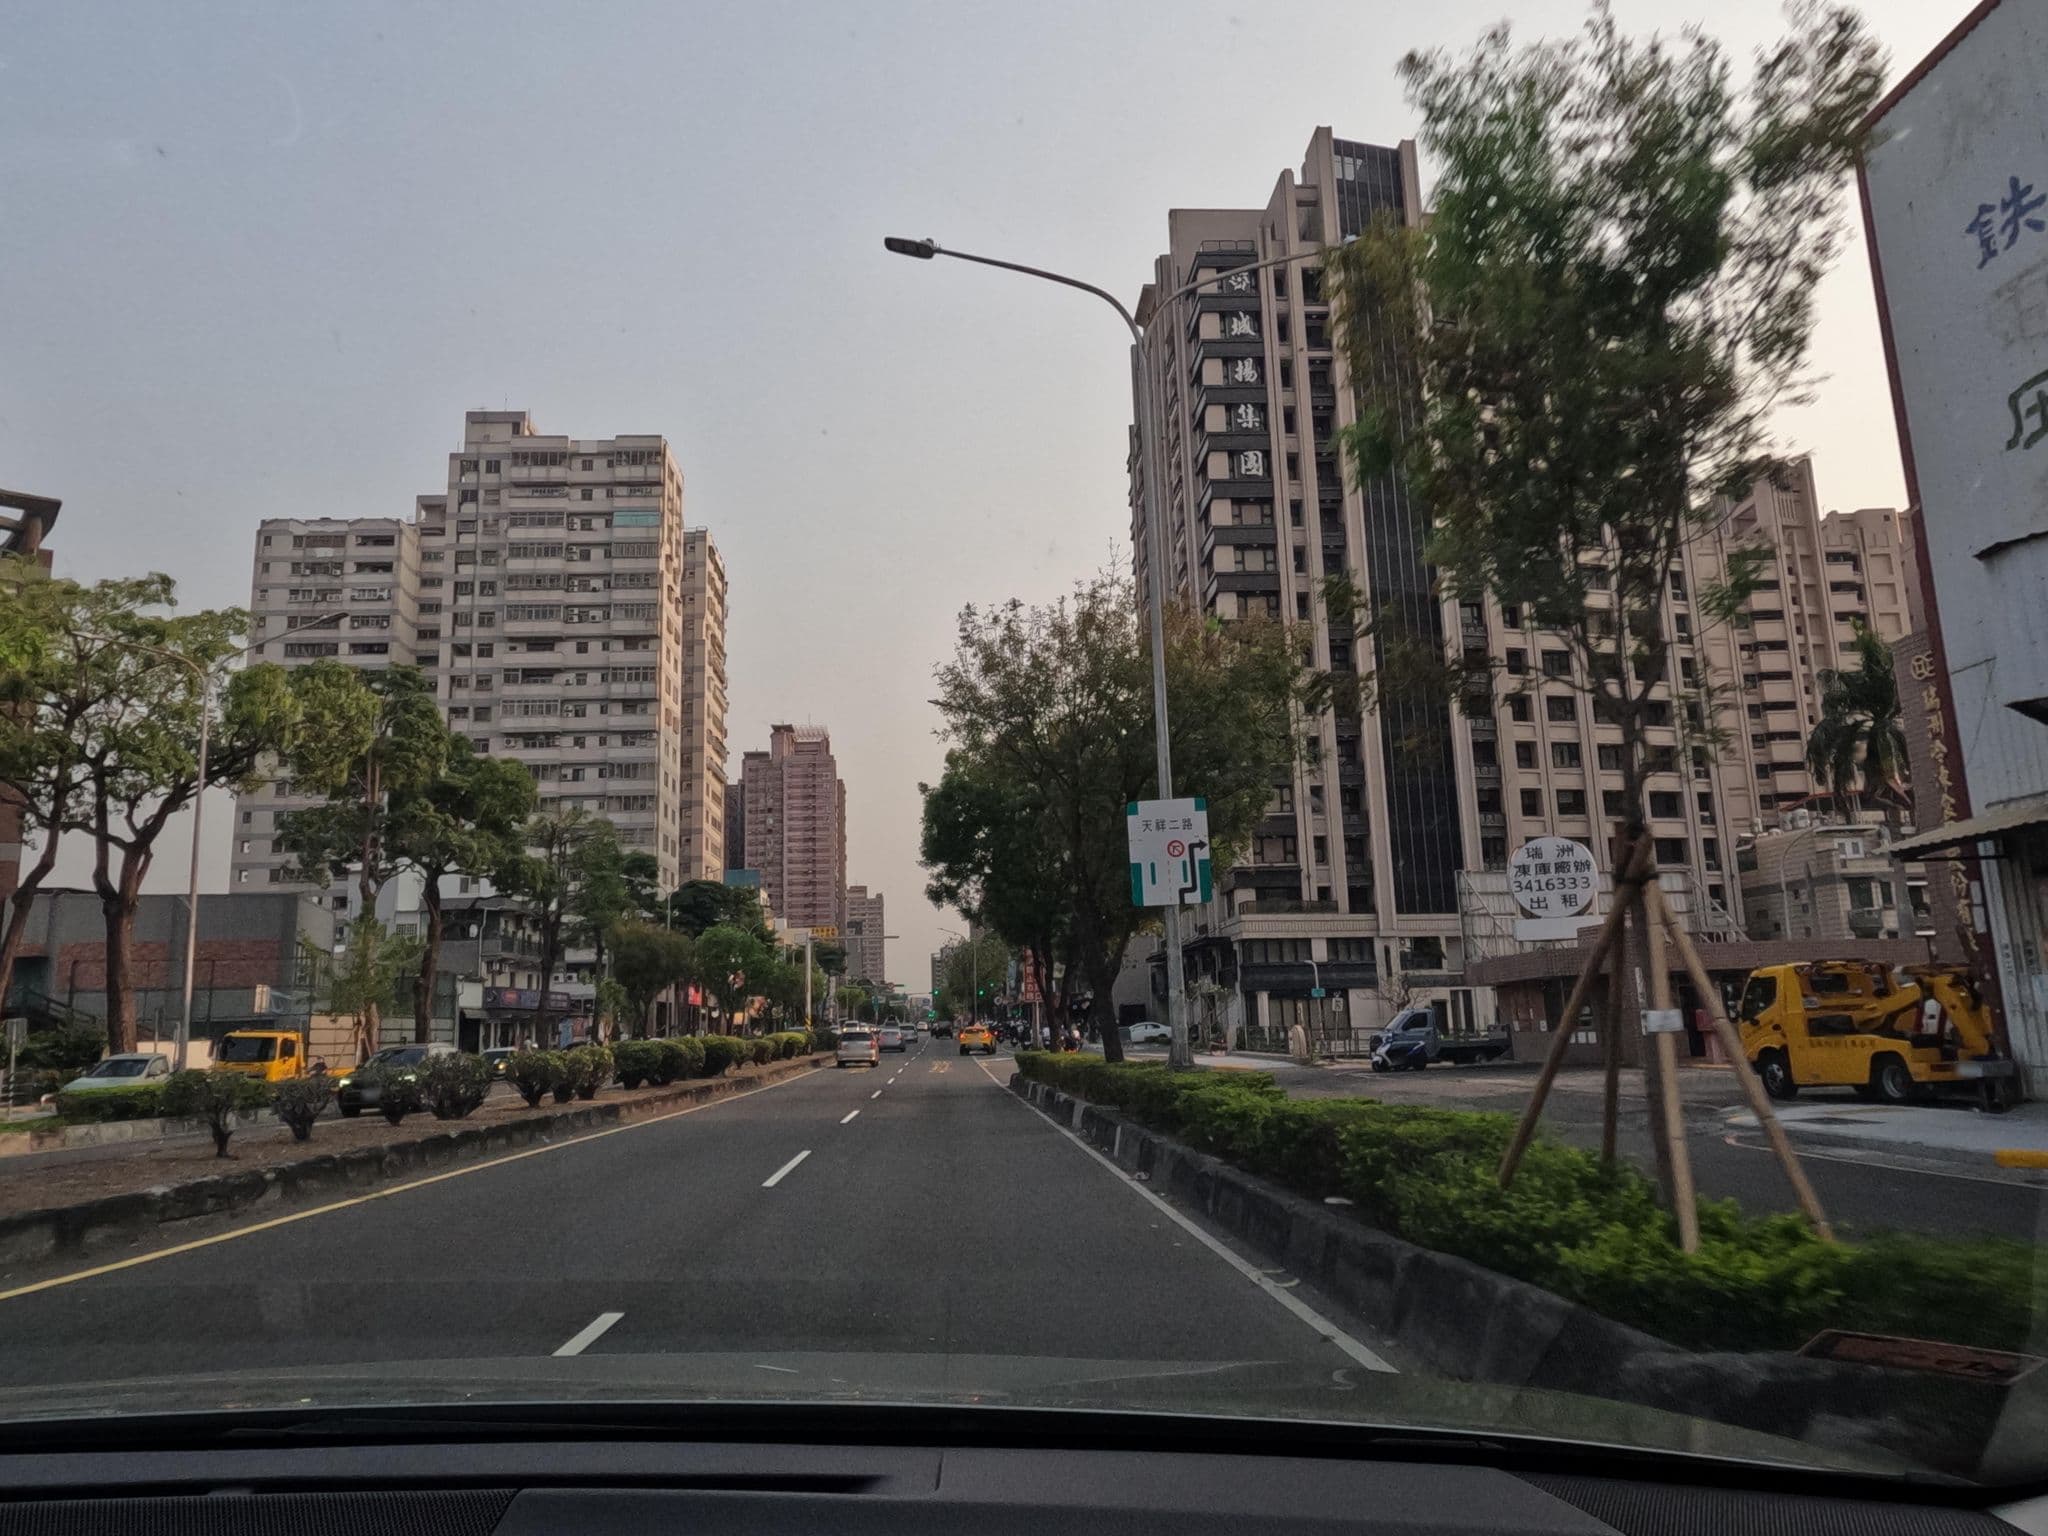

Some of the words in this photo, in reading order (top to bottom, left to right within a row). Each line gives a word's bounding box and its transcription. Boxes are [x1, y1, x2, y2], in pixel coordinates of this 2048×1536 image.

[1231, 312, 1263, 476] 城揚集團
[1142, 818, 1193, 832] 天祥二路
[1526, 845, 1574, 860] 瑞洲
[1513, 860, 1592, 878] 凍庫廠辦
[1513, 877, 1591, 894] 3416333
[1529, 893, 1579, 911] 出租
